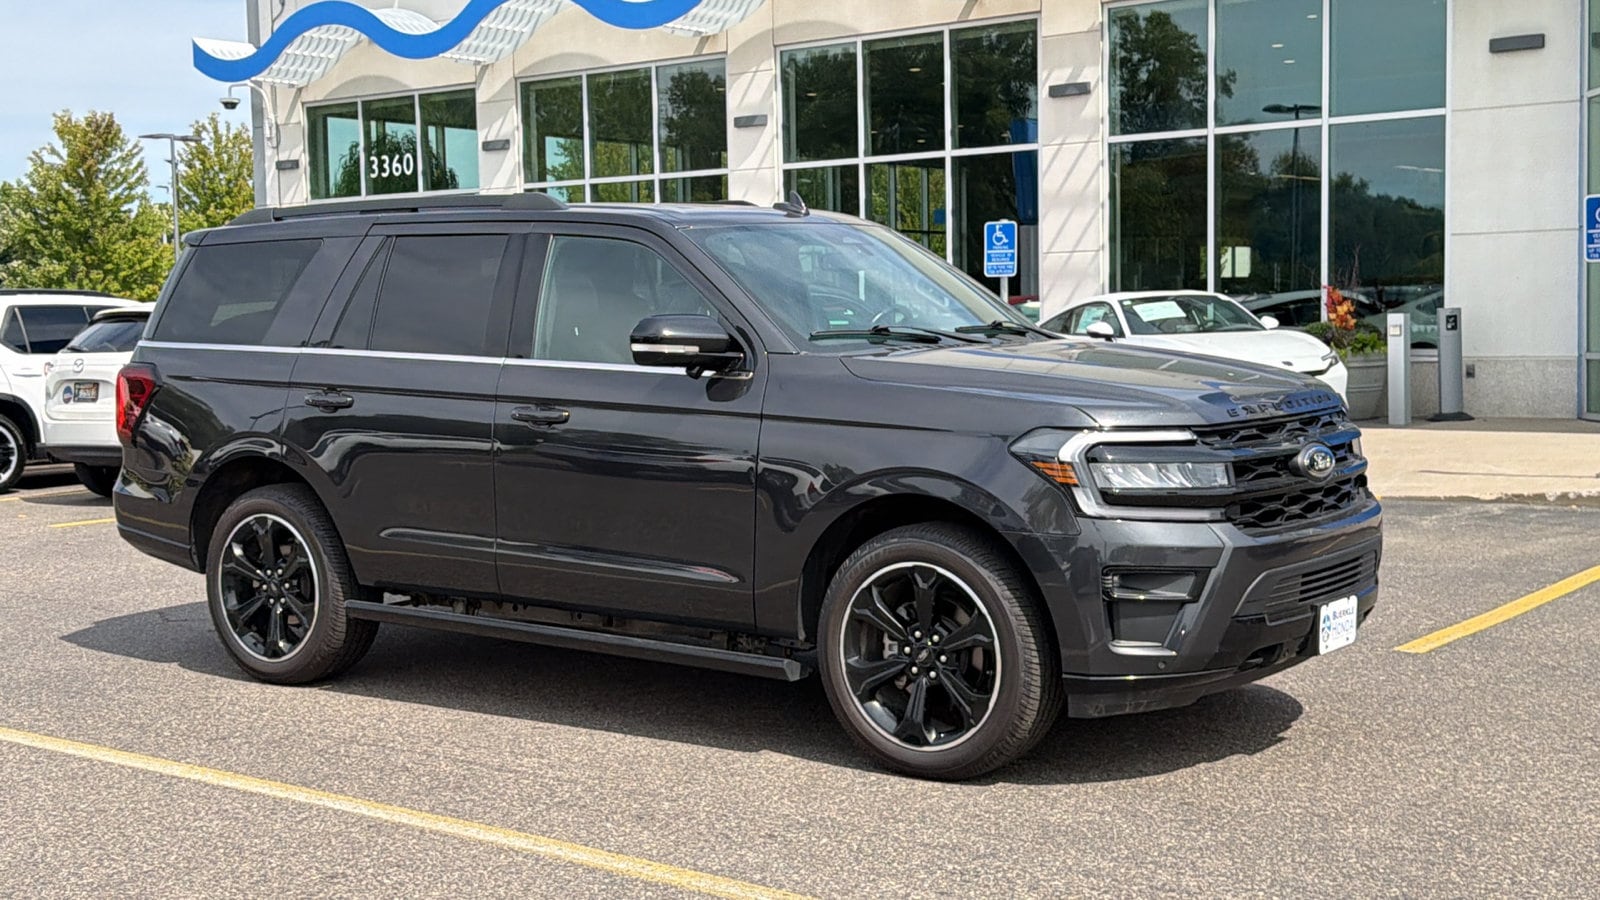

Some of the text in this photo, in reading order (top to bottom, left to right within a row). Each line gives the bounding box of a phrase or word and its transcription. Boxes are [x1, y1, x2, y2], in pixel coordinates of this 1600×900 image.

[370, 153, 414, 178] 3360
[1226, 394, 1331, 418] EXPEDITION
[1332, 619, 1354, 637] HONDA
